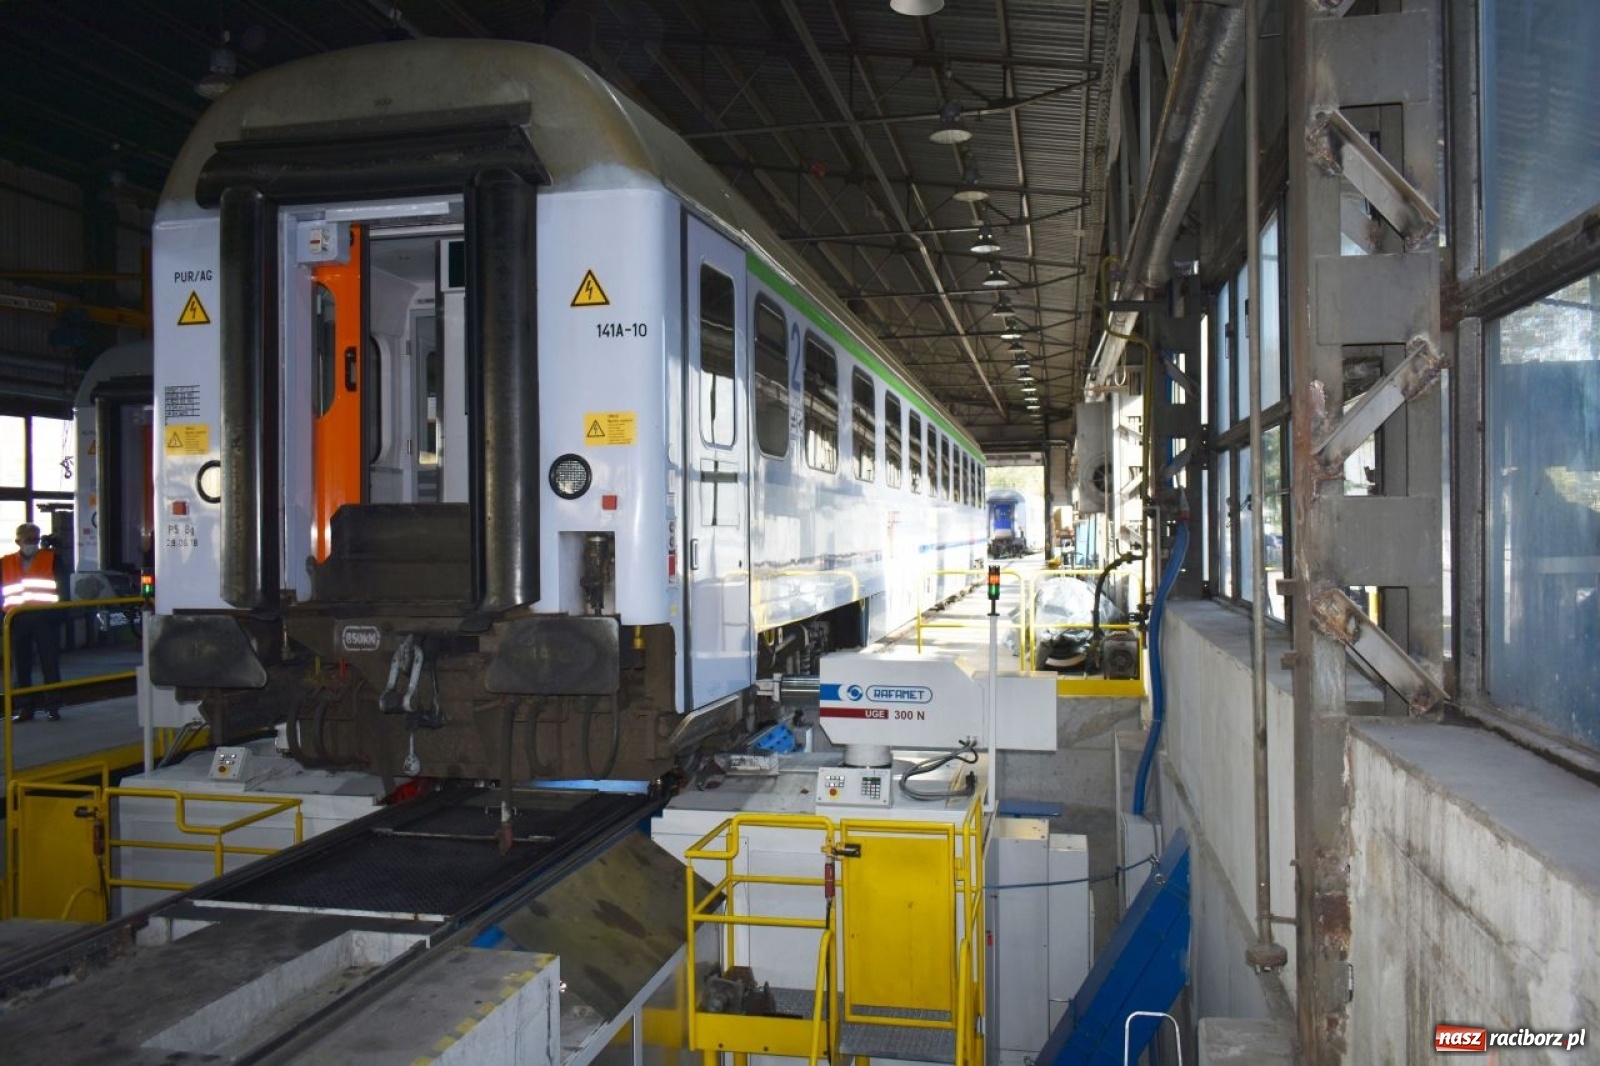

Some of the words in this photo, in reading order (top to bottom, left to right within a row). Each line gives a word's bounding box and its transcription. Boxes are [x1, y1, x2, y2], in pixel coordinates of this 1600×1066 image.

[174, 270, 213, 283] PUR/AG
[597, 323, 648, 338] 141A-10
[873, 689, 926, 700] RAFAMET
[865, 709, 886, 718] UGE
[894, 710, 914, 720] 300
[916, 710, 926, 721] N
